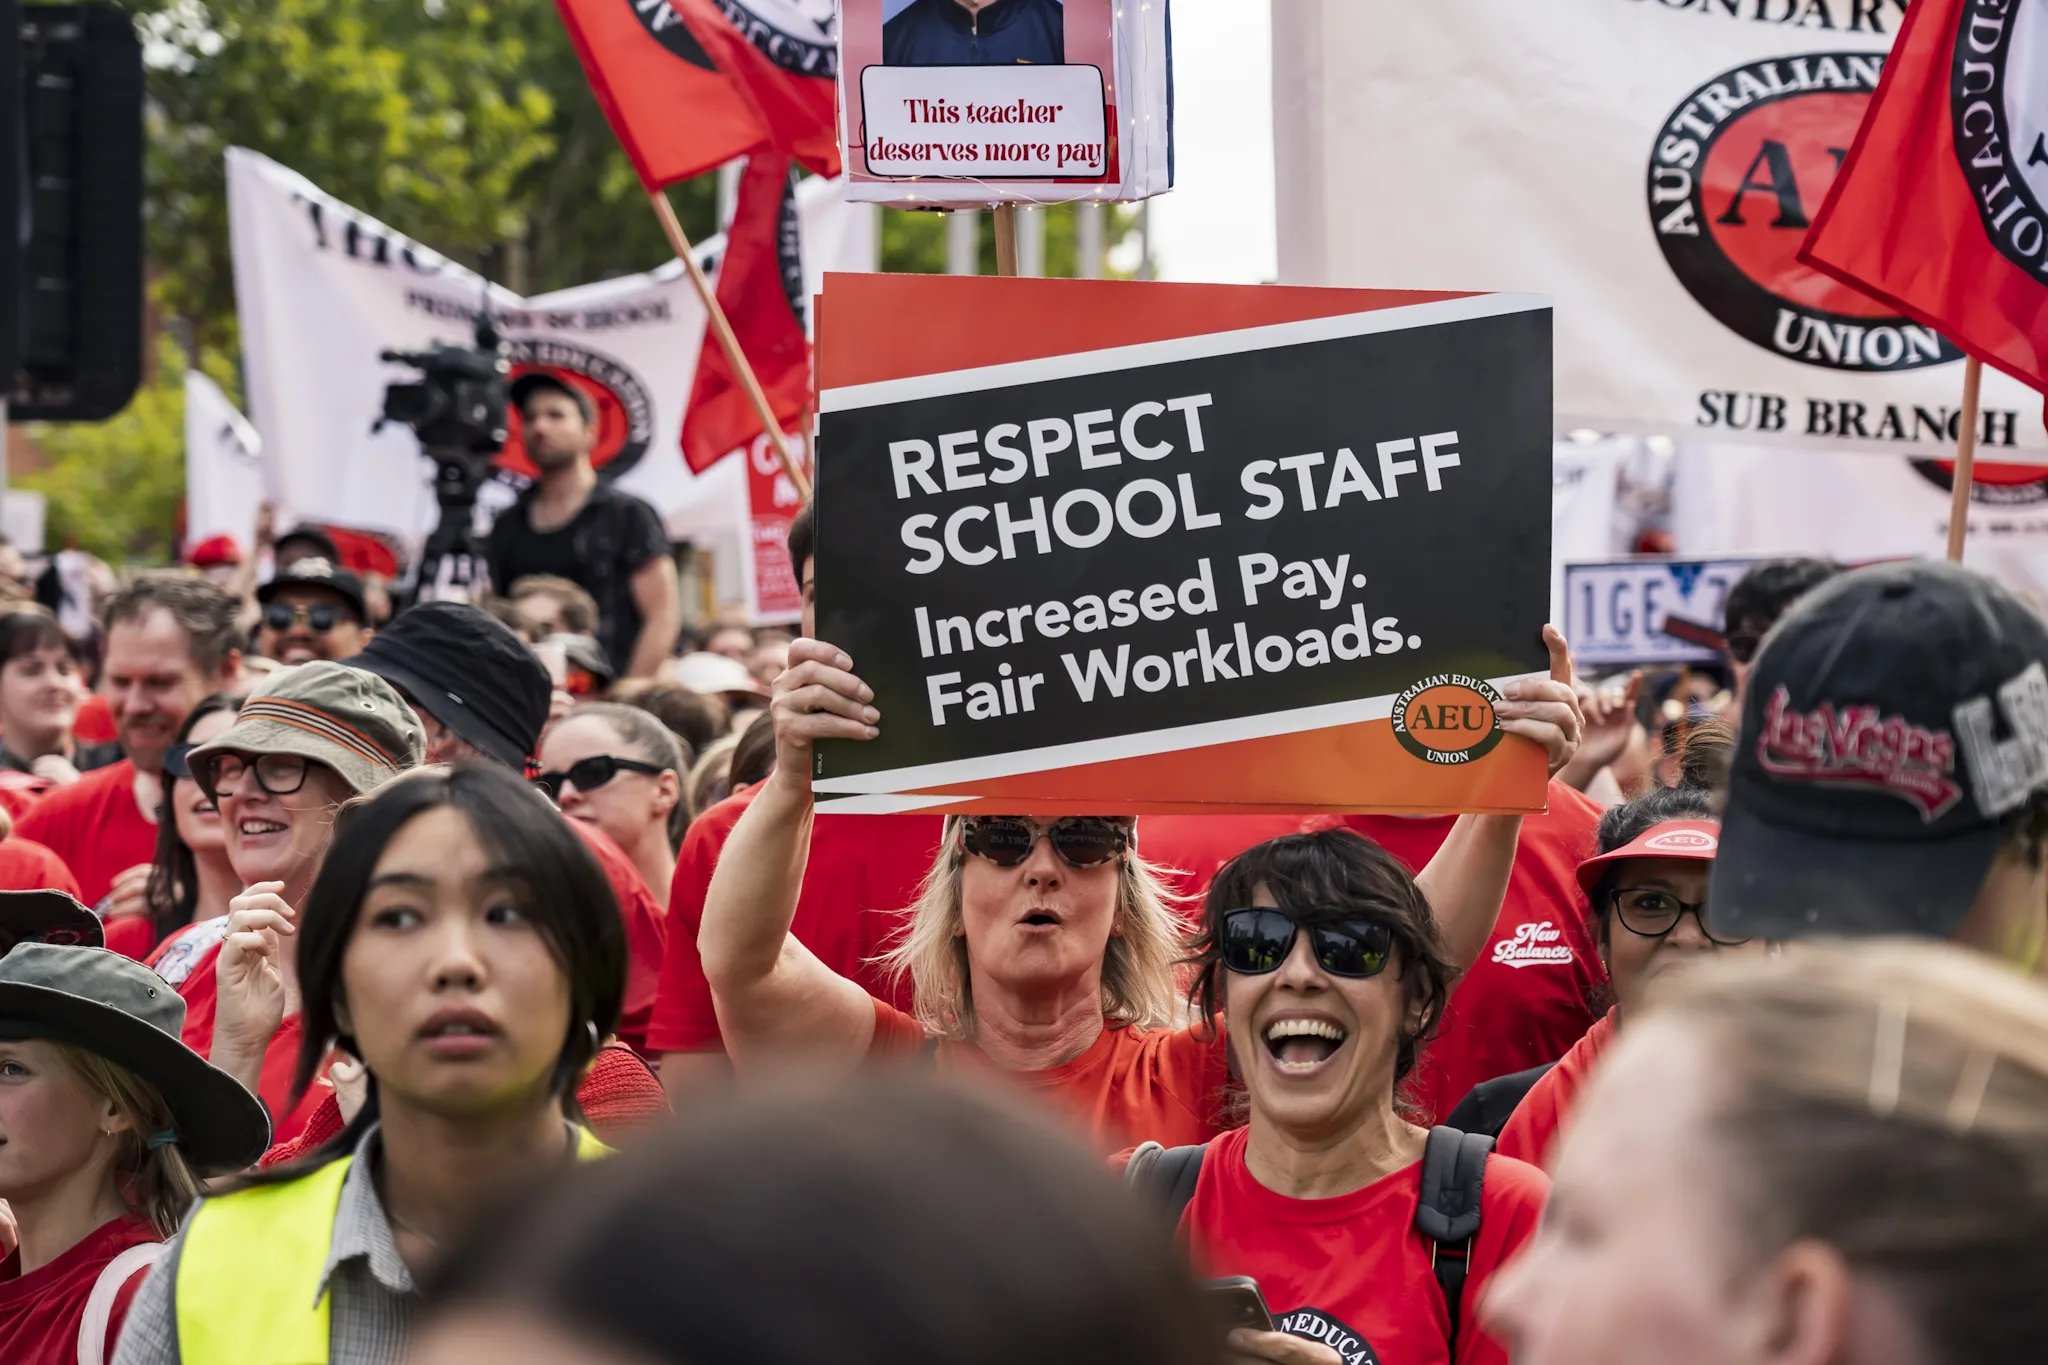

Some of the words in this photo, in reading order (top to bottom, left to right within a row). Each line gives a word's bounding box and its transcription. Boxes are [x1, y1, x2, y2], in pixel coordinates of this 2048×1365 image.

[903, 98, 960, 124] This
[966, 98, 1064, 124] teacher
[869, 136, 979, 162] deserves
[985, 142, 1050, 162] more
[1057, 142, 1102, 168] pay
[1652, 56, 1884, 237] AUSTRALIAN
[1773, 308, 1942, 366] UNION
[1697, 389, 1787, 432] SUB
[889, 393, 1213, 499] RESPECT
[900, 472, 1222, 575] SCHOOL
[1240, 431, 1461, 520] STAFF
[914, 558, 1218, 658] Increased
[1238, 553, 1367, 610] Pay.
[925, 663, 1045, 727] Fair
[1061, 603, 1423, 703] Workloads.
[1392, 674, 1449, 733] AUSTRALIAN
[1410, 705, 1487, 731] AEU
[1426, 749, 1470, 764] UNION
[1658, 836, 1707, 846] AEU
[1492, 939, 1573, 964] Balance
[1515, 921, 1561, 945] New
